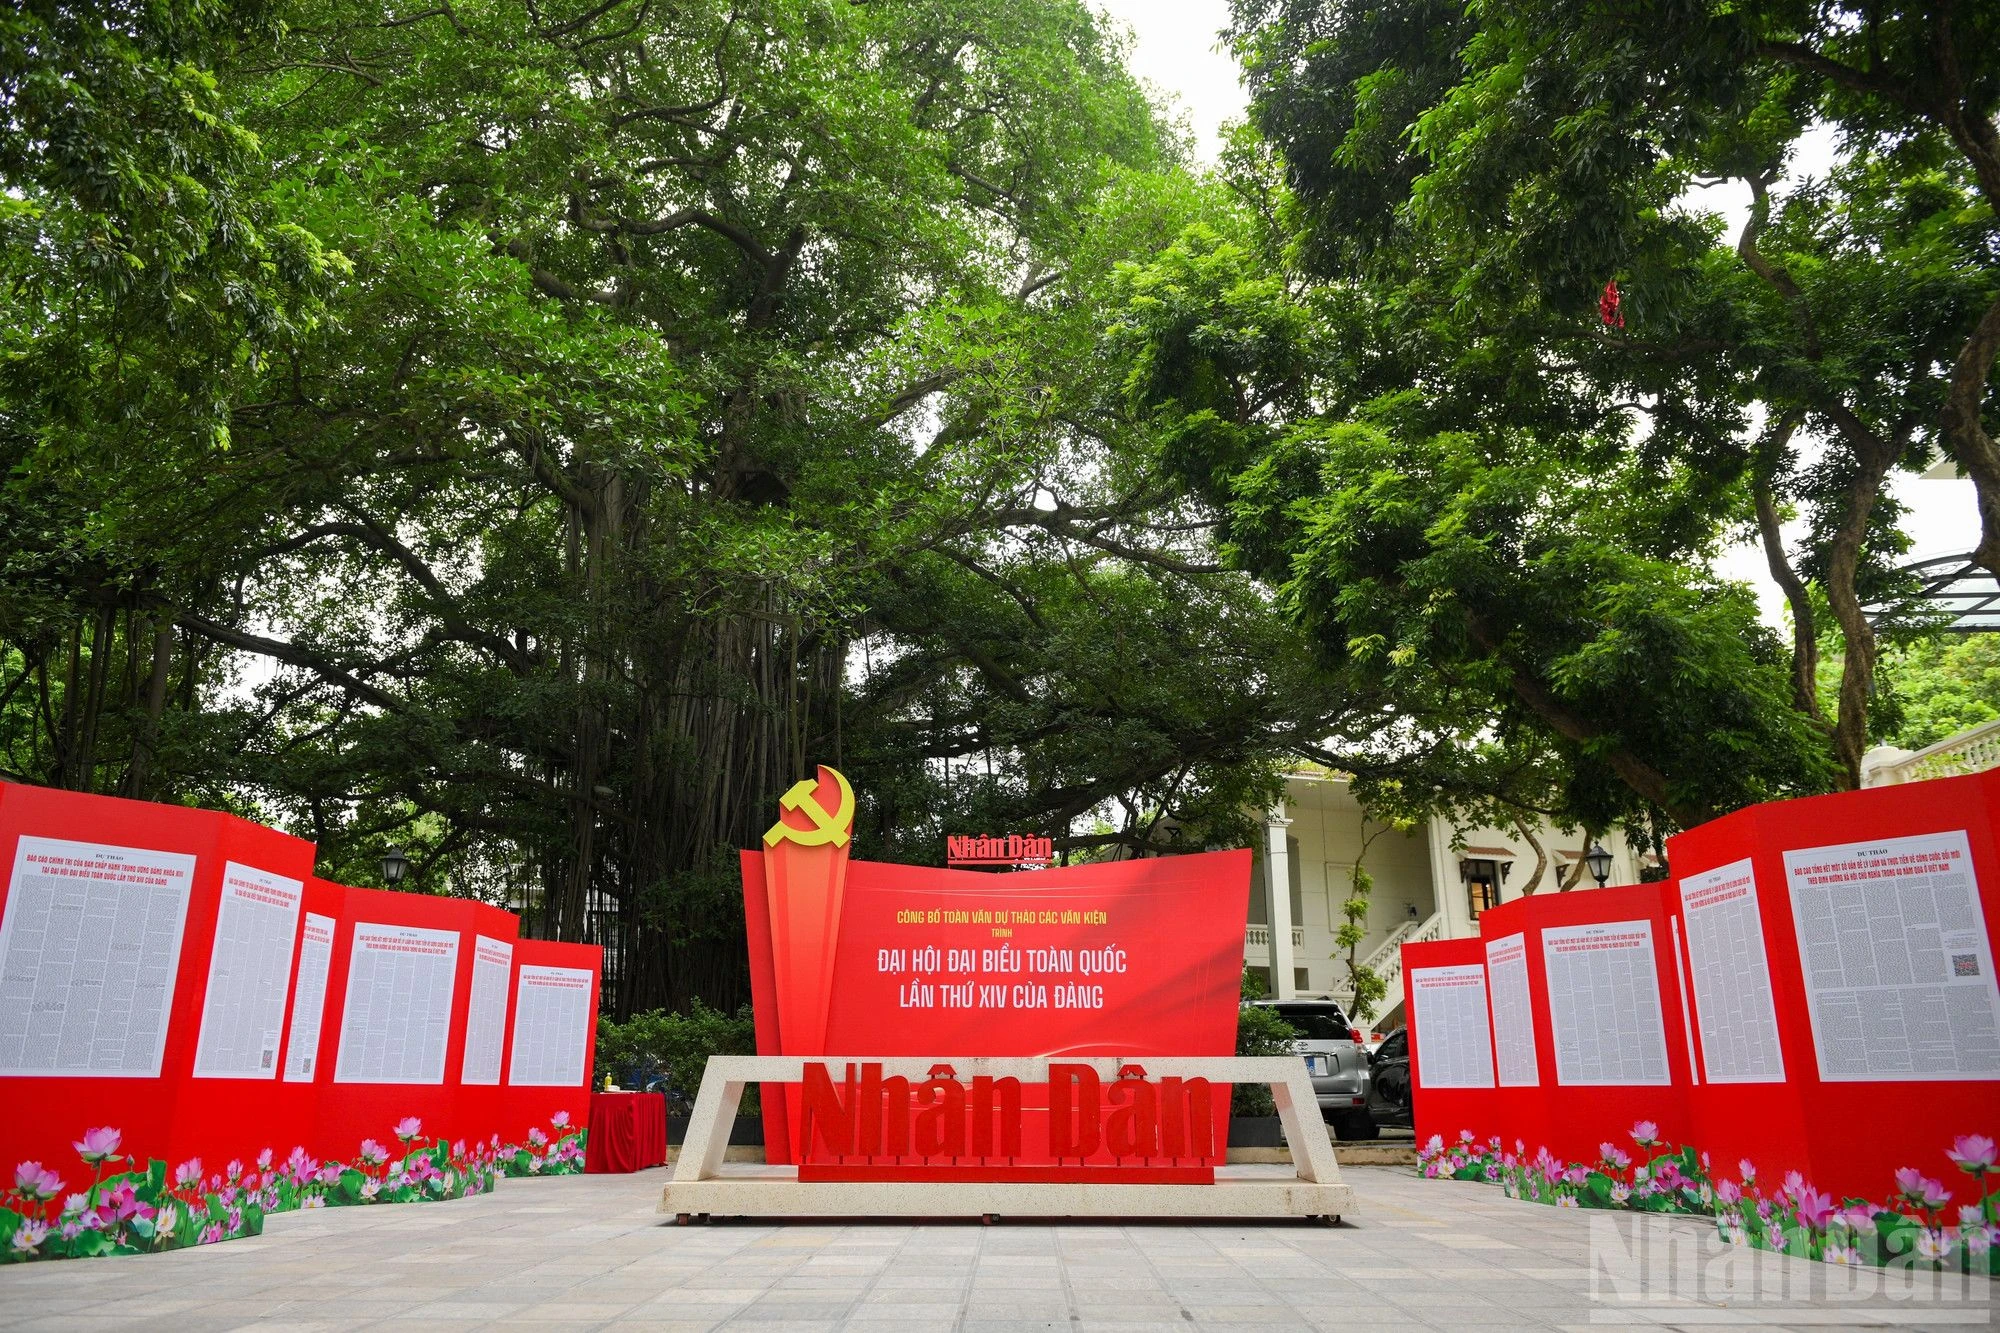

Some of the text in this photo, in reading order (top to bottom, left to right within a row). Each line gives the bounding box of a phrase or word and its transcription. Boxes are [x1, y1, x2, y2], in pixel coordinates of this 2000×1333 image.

[947, 833, 1052, 858] Nhân Dân
[897, 907, 1106, 925] CÔNG BỐ TOÀN VĂN DỰ THẢO CÁC VĂN KIỆN
[992, 928, 1012, 938] TRÌNH
[878, 942, 1126, 976] ĐẠI HỘI ĐẠI BIỂU TOÀN QUỐC
[900, 978, 1104, 1008] LẦN THỨ XIV CỦA ĐẢNG
[802, 1062, 1214, 1158] Nhân Dân
